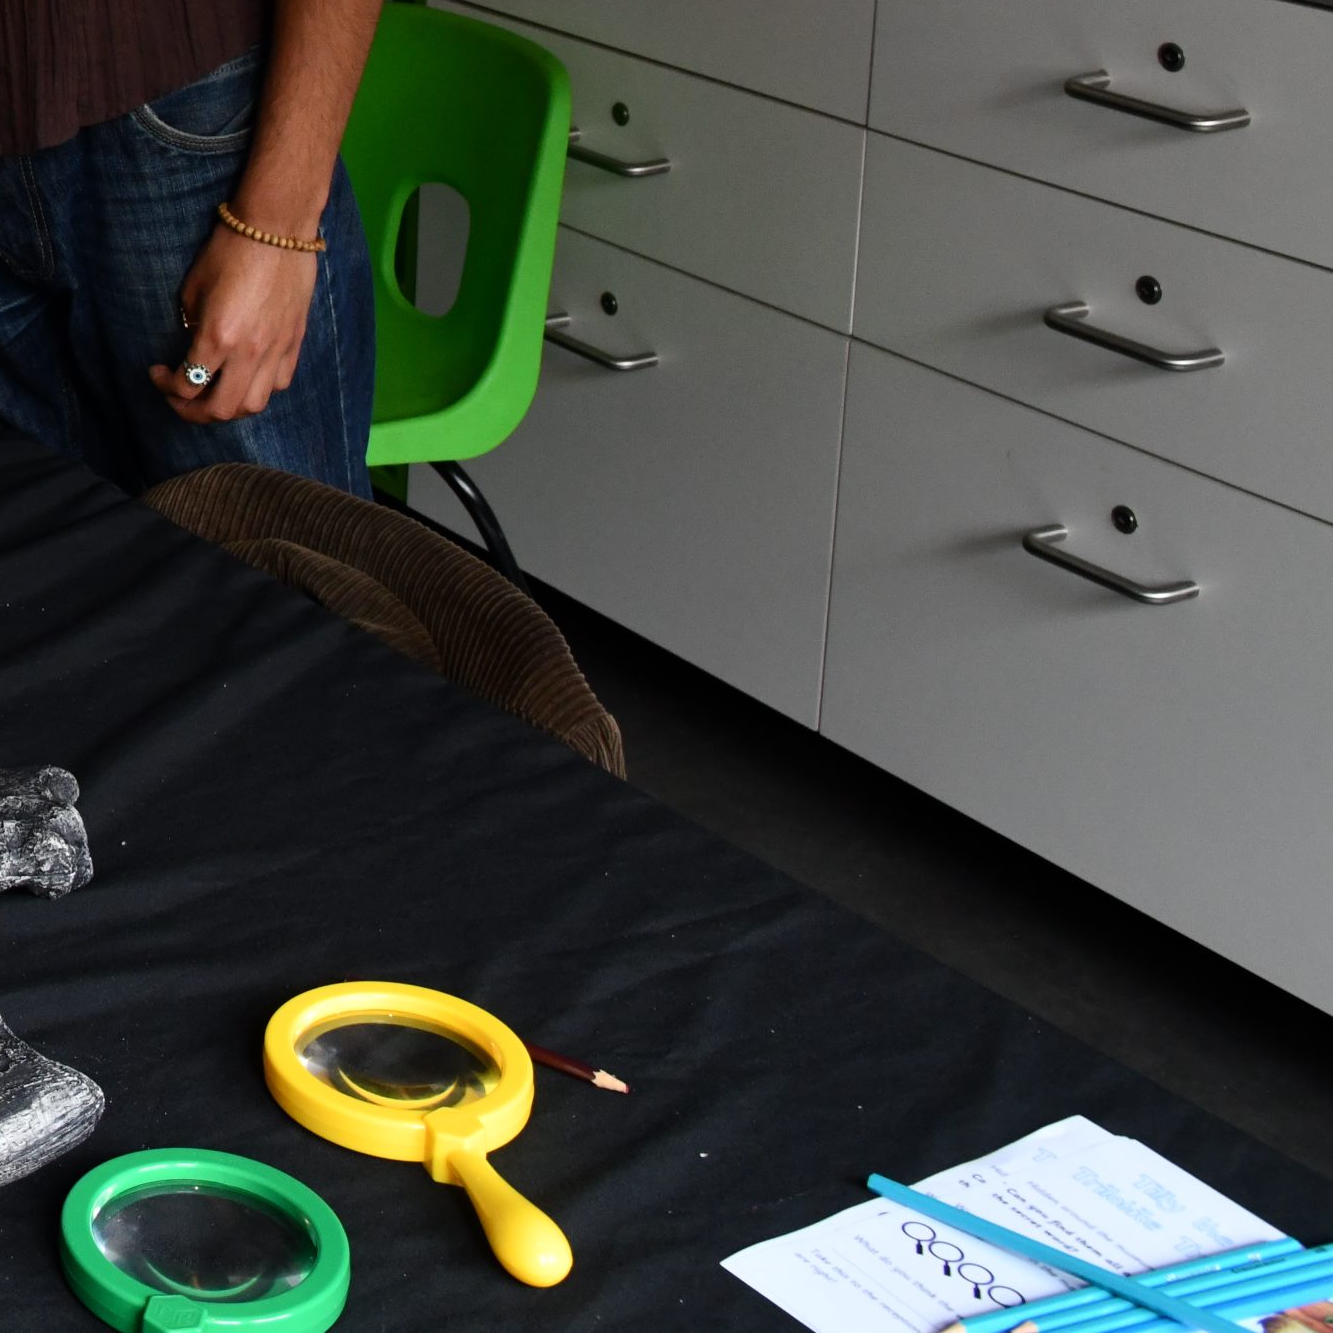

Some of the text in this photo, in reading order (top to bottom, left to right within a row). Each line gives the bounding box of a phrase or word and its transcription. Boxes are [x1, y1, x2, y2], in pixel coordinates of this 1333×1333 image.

[991, 1192, 1080, 1253] the secret word?
[1006, 1187, 1124, 1270] Can you find them all
[793, 1252, 811, 1264] are
[811, 1249, 833, 1266] Take
[861, 1288, 879, 1301] the
[853, 1234, 955, 1313] What do you think the
